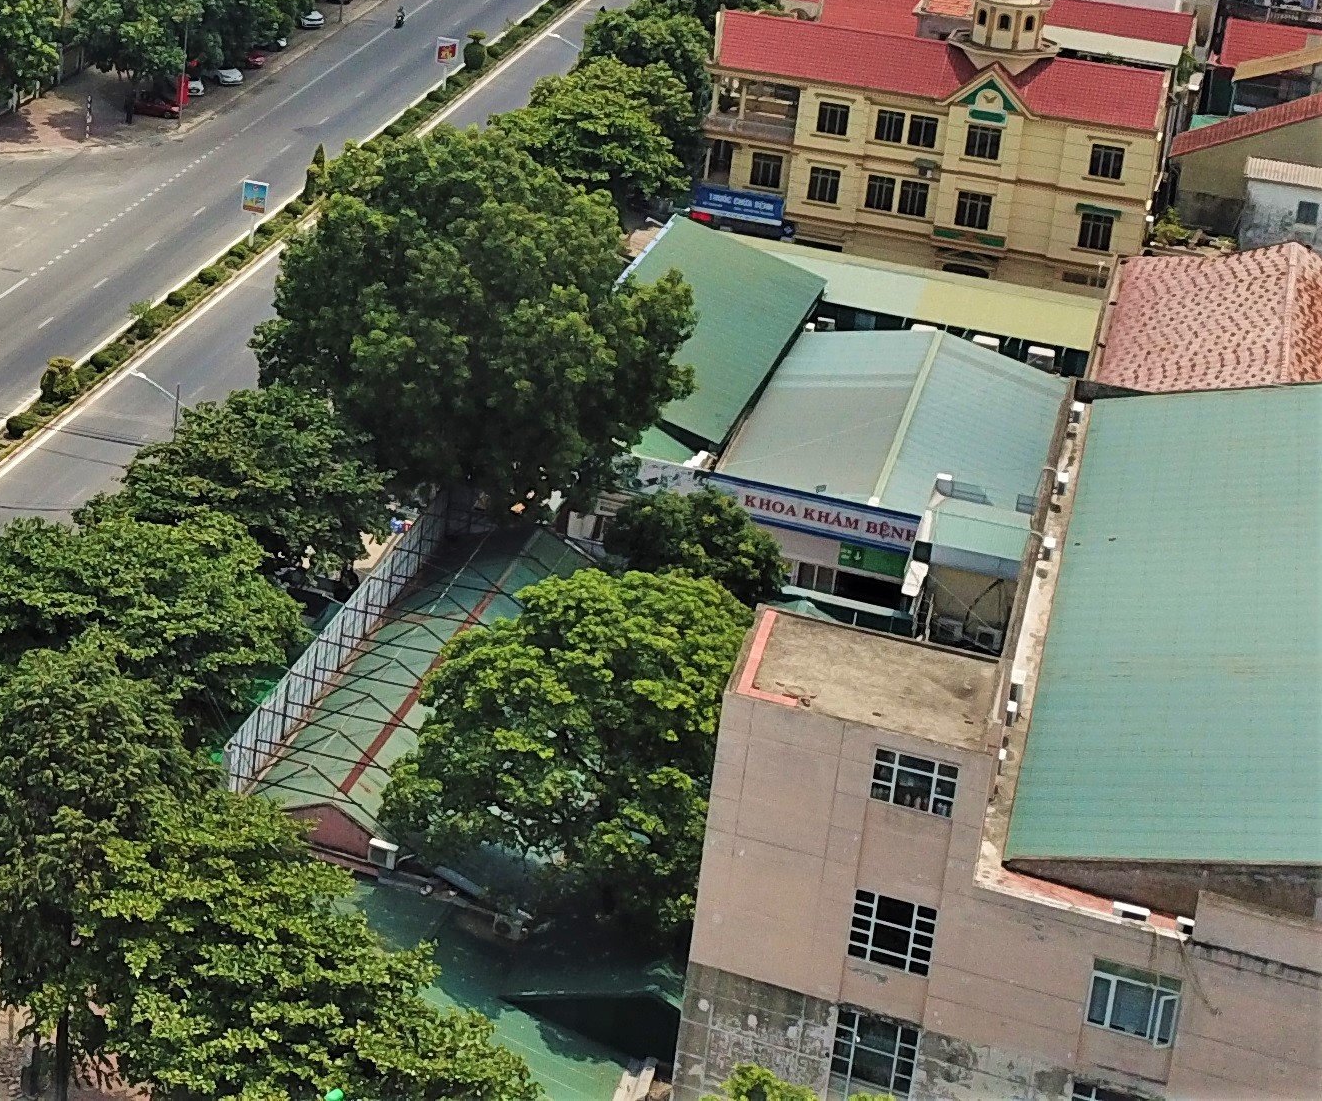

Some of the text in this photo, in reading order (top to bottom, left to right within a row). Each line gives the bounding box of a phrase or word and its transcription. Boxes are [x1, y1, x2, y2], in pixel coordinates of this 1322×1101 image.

[743, 494, 918, 543] KHOA KHÁM BỆNH
